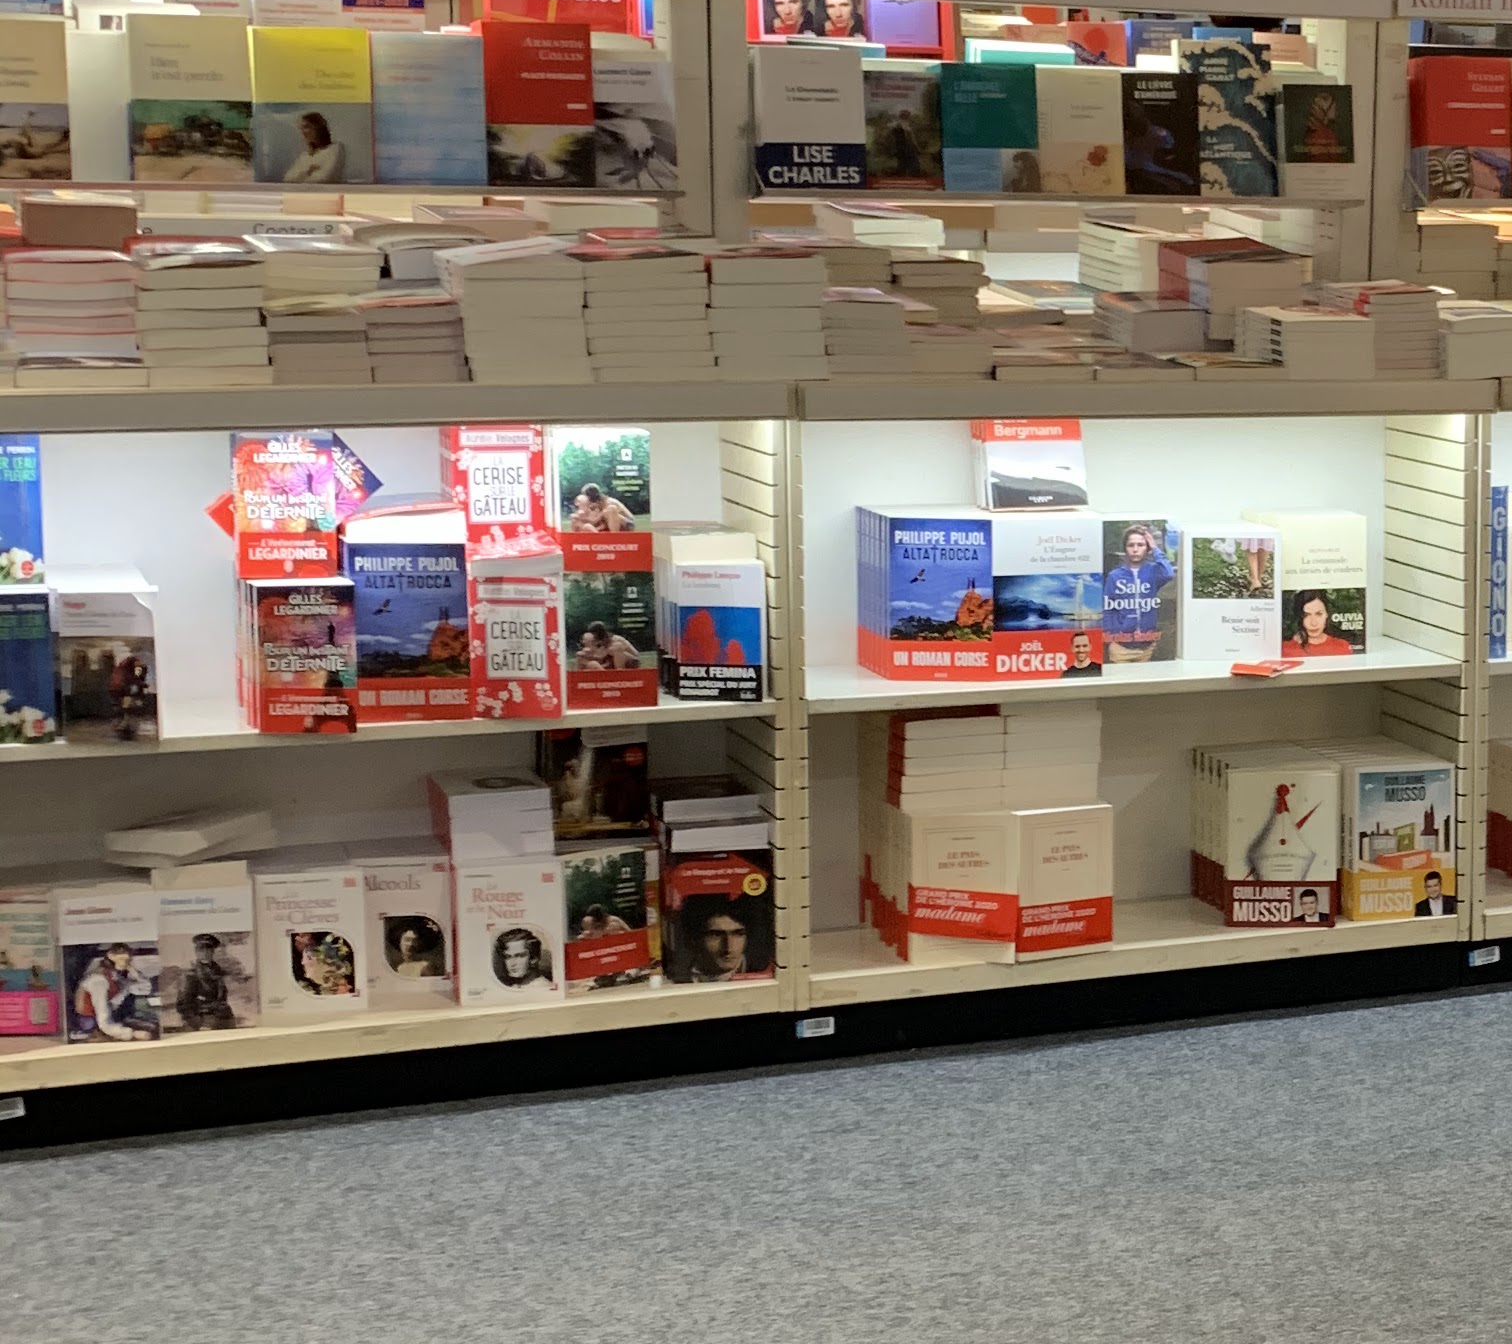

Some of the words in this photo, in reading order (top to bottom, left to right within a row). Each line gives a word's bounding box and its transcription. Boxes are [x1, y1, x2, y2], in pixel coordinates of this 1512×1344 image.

[792, 146, 833, 163] LISE
[768, 166, 860, 184] CHARLES
[994, 425, 1062, 439] Bergmann
[473, 467, 525, 486] CERISE
[473, 494, 527, 517] GÂTEAU
[895, 531, 946, 547] PHILIPPE
[950, 530, 987, 547] PUJOL
[248, 548, 328, 561] LEGARDINIER
[354, 557, 412, 572] PHILIPPE
[418, 556, 459, 572] PUJOL
[1115, 579, 1150, 594] Sale
[288, 594, 323, 605] GILLES
[1104, 596, 1162, 612] bourge
[274, 605, 339, 616] LEGARDINIER
[1331, 613, 1364, 623] OLIVIA
[490, 621, 541, 640] CERISE
[1341, 621, 1364, 631] RUIZ
[1020, 640, 1043, 651] JOËL
[490, 651, 544, 671] GÂTEAU
[996, 655, 1067, 672] DICKER
[680, 666, 708, 678] PRIX
[709, 666, 756, 678] FEMINA
[269, 703, 350, 716] LEGARDINIER
[1384, 787, 1426, 802] MUSSO
[472, 888, 524, 907] Rouge
[1233, 887, 1291, 900] GUILLAUME
[1359, 892, 1414, 914] MUSSO
[488, 906, 527, 919] Noir
[914, 906, 987, 925] madame
[1232, 902, 1292, 922] MUSSO
[1023, 918, 1087, 937] madame
